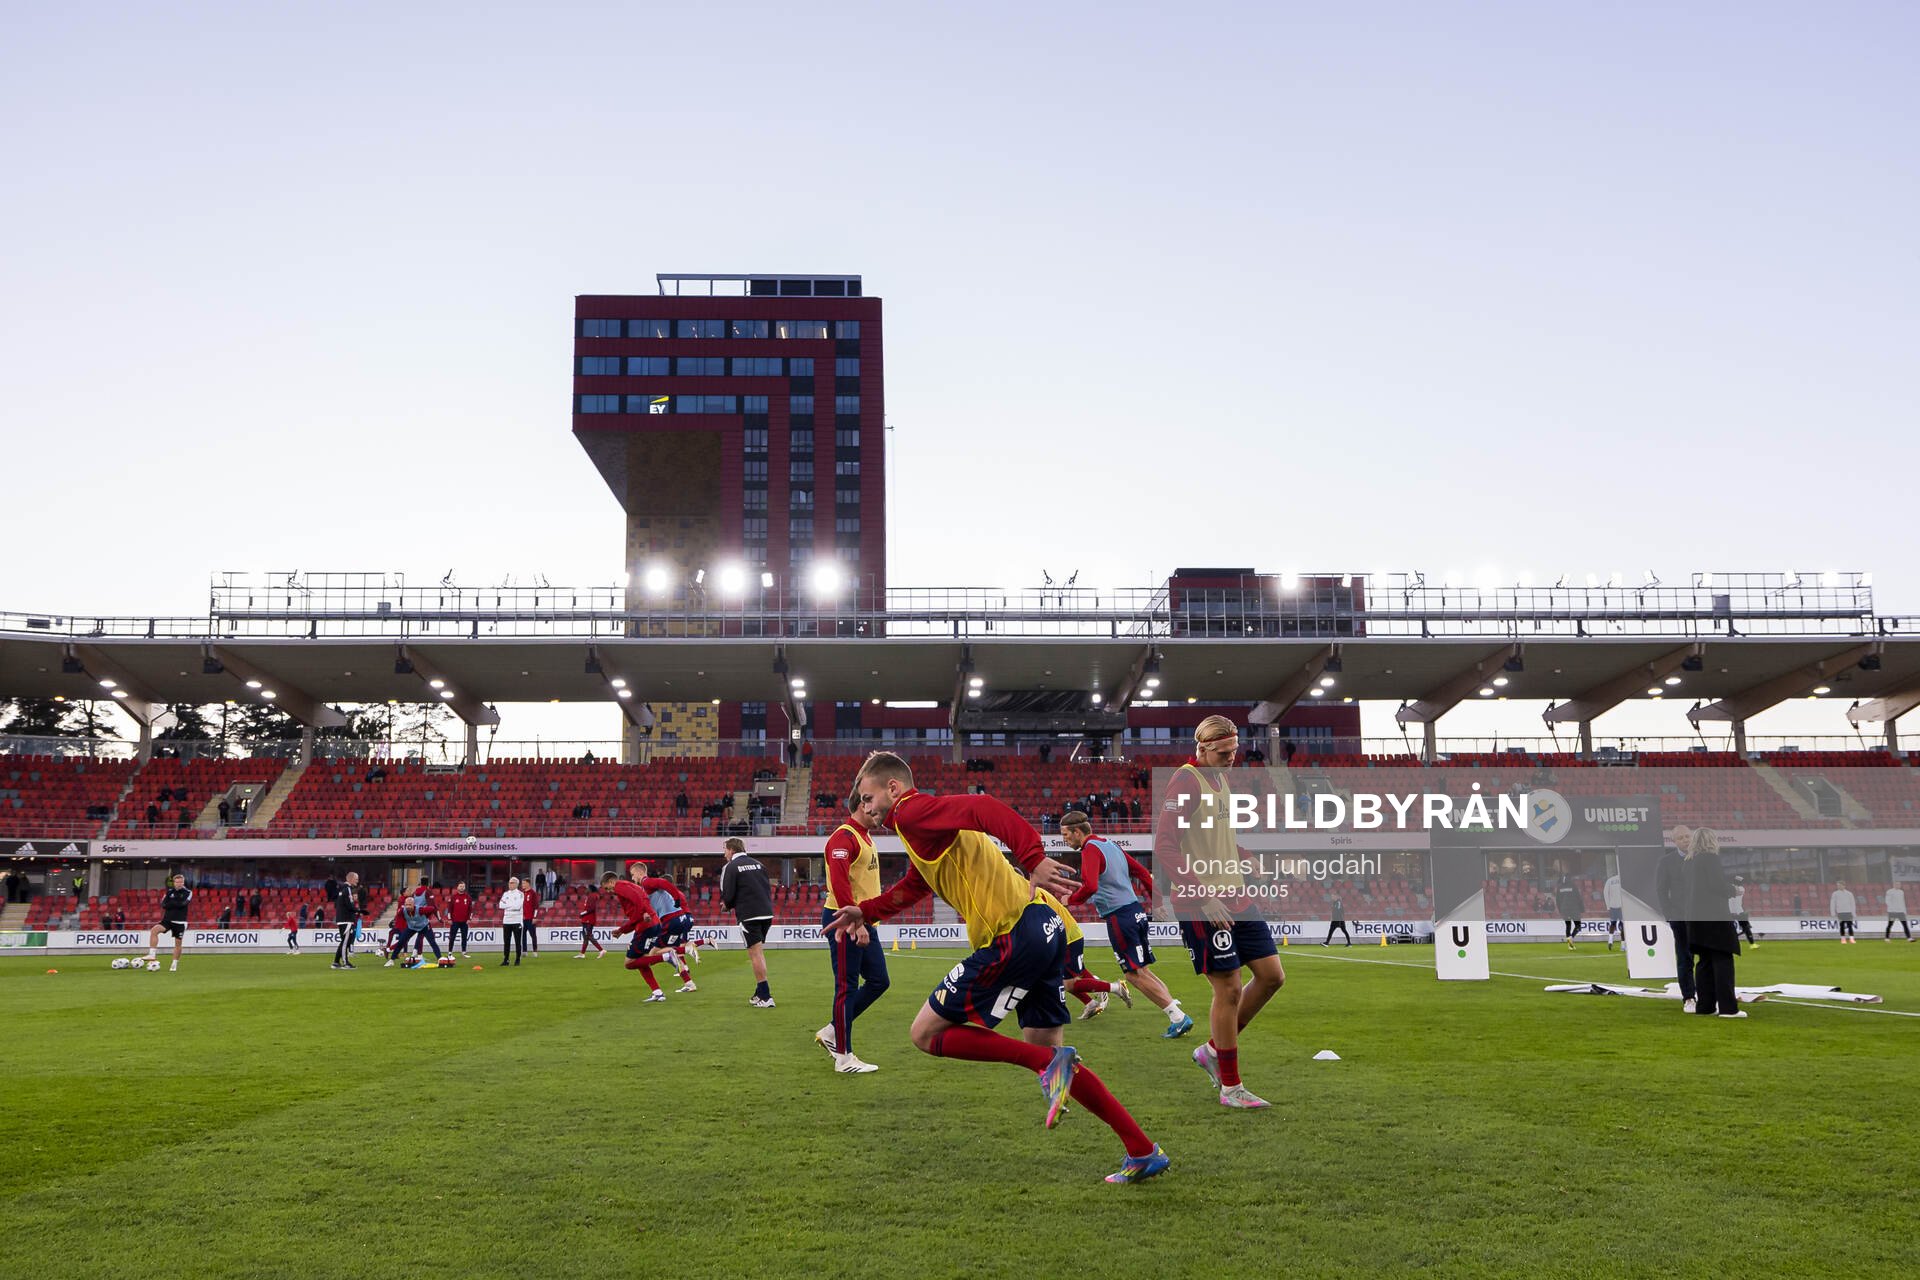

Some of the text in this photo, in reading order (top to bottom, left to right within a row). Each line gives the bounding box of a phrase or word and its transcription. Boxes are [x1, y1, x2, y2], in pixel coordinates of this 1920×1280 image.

[649, 404, 666, 415] EY
[1584, 807, 1649, 823] UNIBET
[102, 844, 126, 854] Spiris
[346, 841, 518, 854] Smartare bokföring. Smidigare business.
[783, 928, 824, 939] PREM
[899, 927, 959, 939] PREMON
[1355, 923, 1414, 935] PREMON
[1485, 922, 1526, 933] EMON
[76, 933, 139, 945] PREMON
[195, 932, 258, 944] PREMON
[314, 932, 377, 943] PREON
[550, 930, 612, 941] PREON
[1452, 926, 1469, 947] U
[1641, 925, 1658, 946] U
